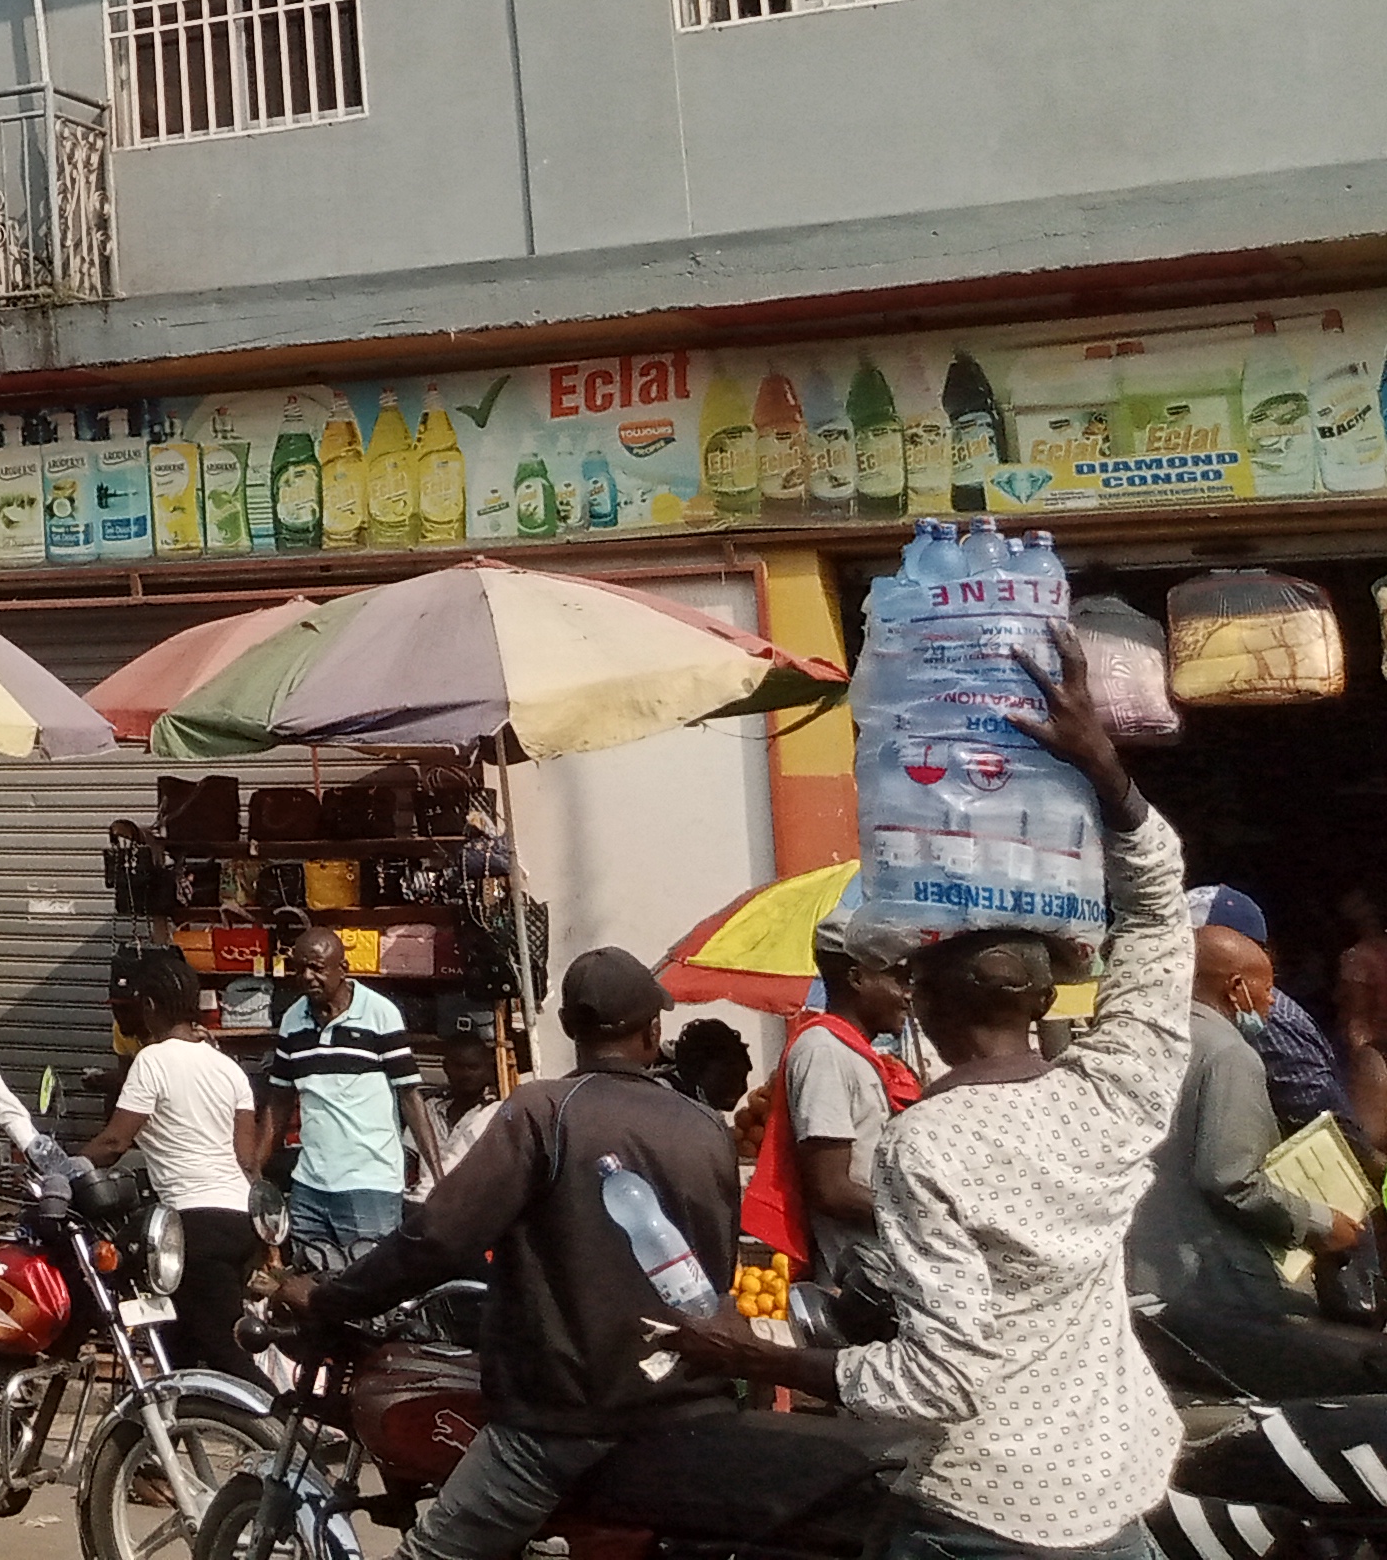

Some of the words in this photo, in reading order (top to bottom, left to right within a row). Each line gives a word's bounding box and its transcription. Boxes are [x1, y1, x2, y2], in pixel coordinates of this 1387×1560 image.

[549, 350, 691, 420] Eclat
[1075, 452, 1239, 475] DIAMOND
[1101, 468, 1224, 488] CONGO
[913, 880, 1036, 915] EXTENDER
